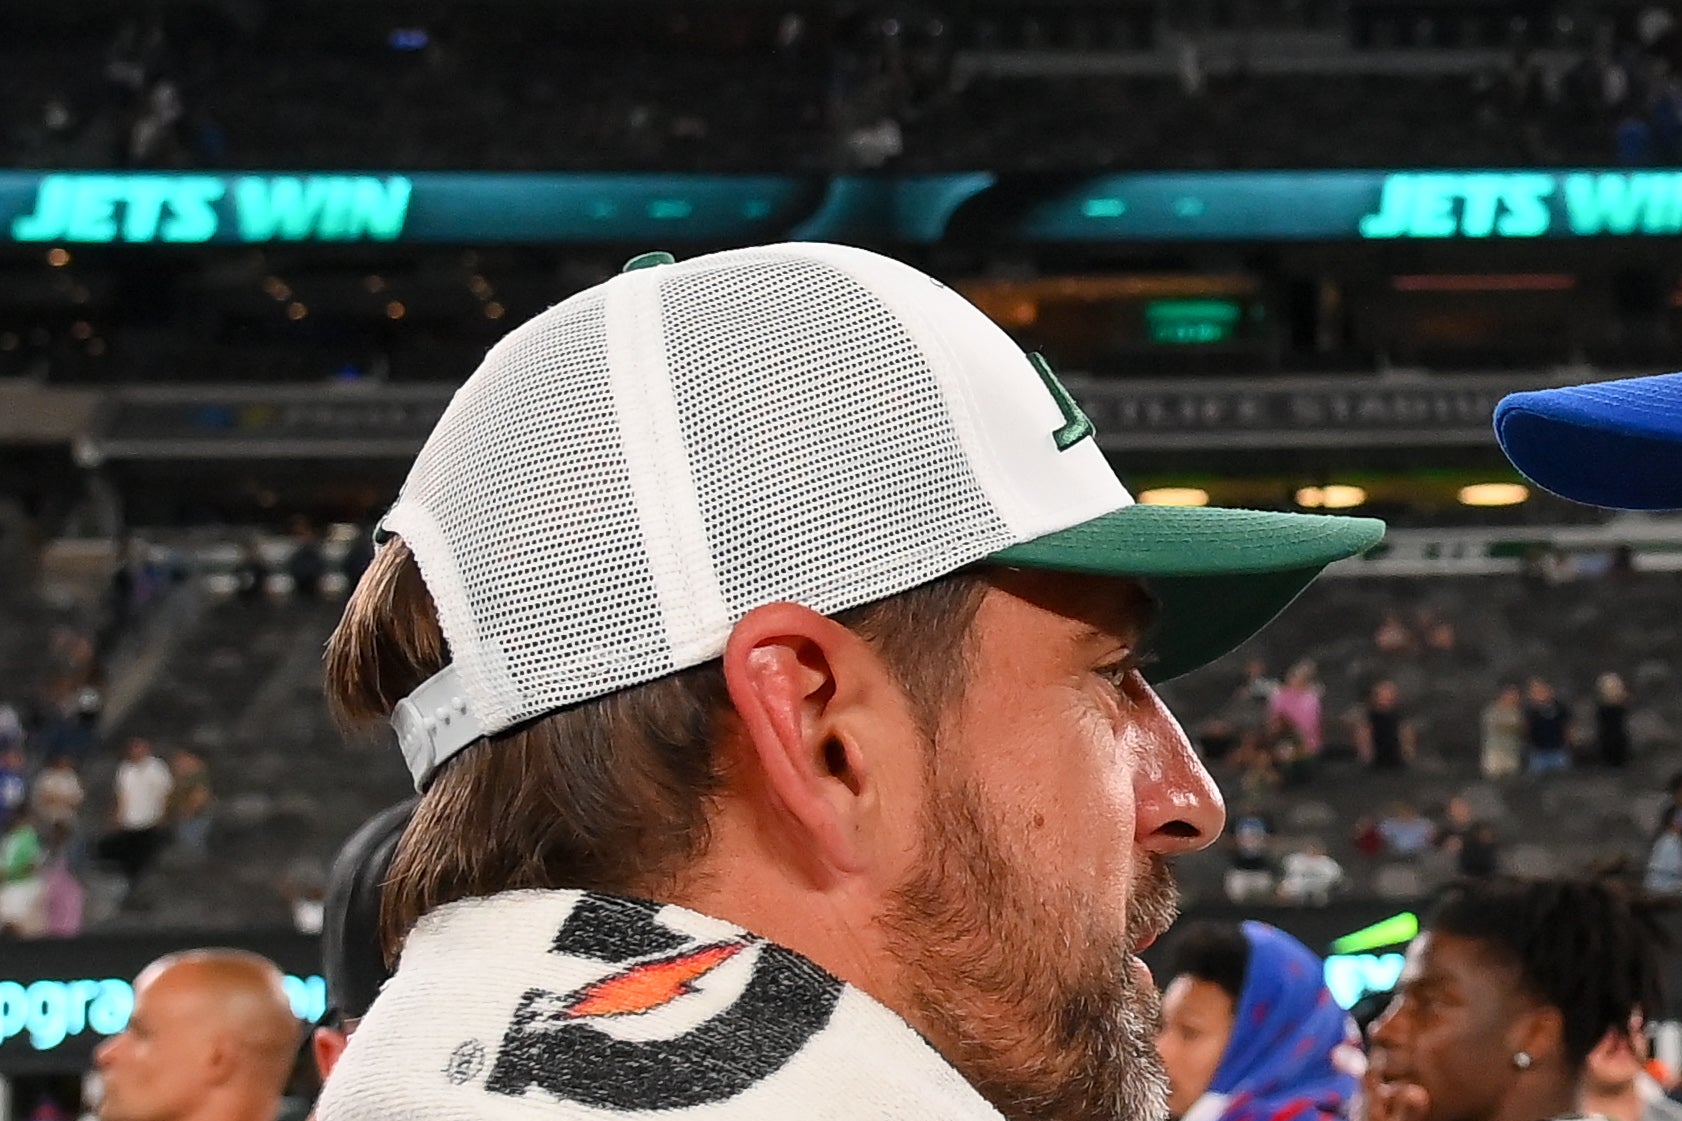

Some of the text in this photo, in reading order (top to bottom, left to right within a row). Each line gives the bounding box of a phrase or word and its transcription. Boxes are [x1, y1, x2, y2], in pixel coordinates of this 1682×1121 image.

[12, 175, 413, 243] JETS WIN
[1359, 171, 1556, 239] JETS
